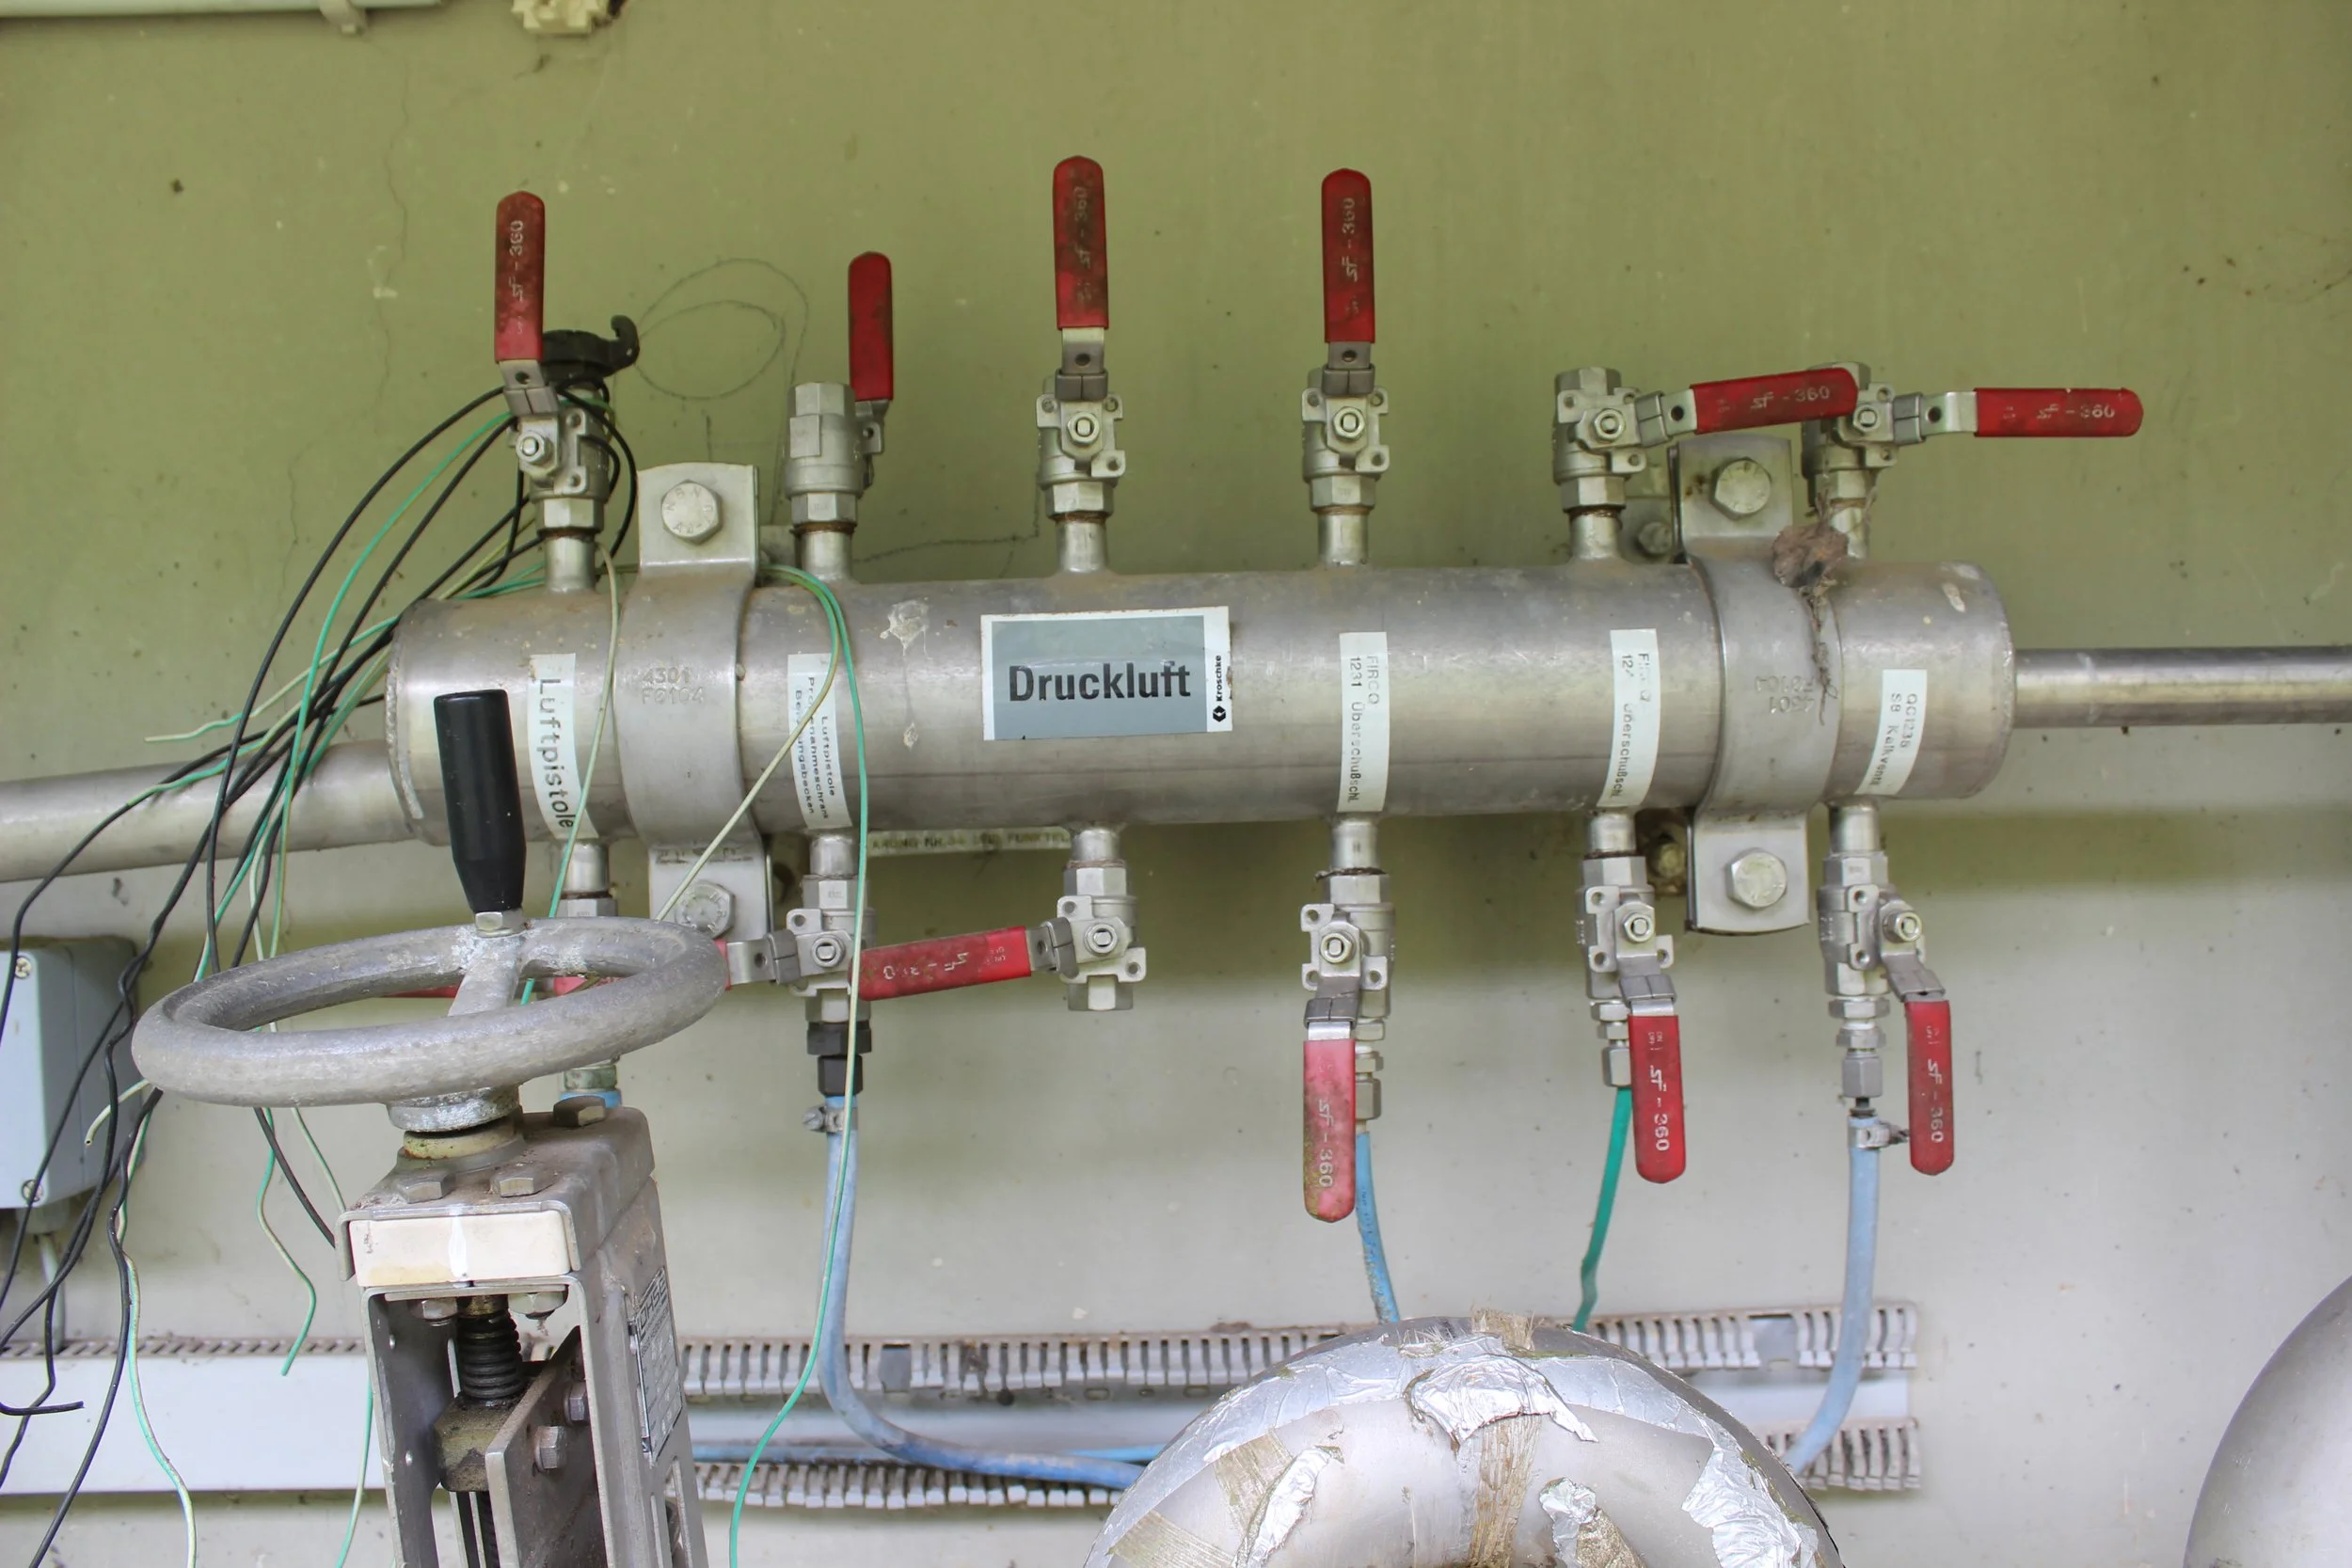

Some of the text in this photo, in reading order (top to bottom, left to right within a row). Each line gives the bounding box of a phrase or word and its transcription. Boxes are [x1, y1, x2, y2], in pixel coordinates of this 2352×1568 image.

[1009, 660, 1190, 702] Druckluft
[537, 677, 576, 829] Luftpistole
[807, 677, 828, 819] Proenahmeschrank
[821, 716, 835, 797] Luftpistole
[1654, 1113, 1670, 1151] 360
[1931, 1106, 1945, 1143] 360
